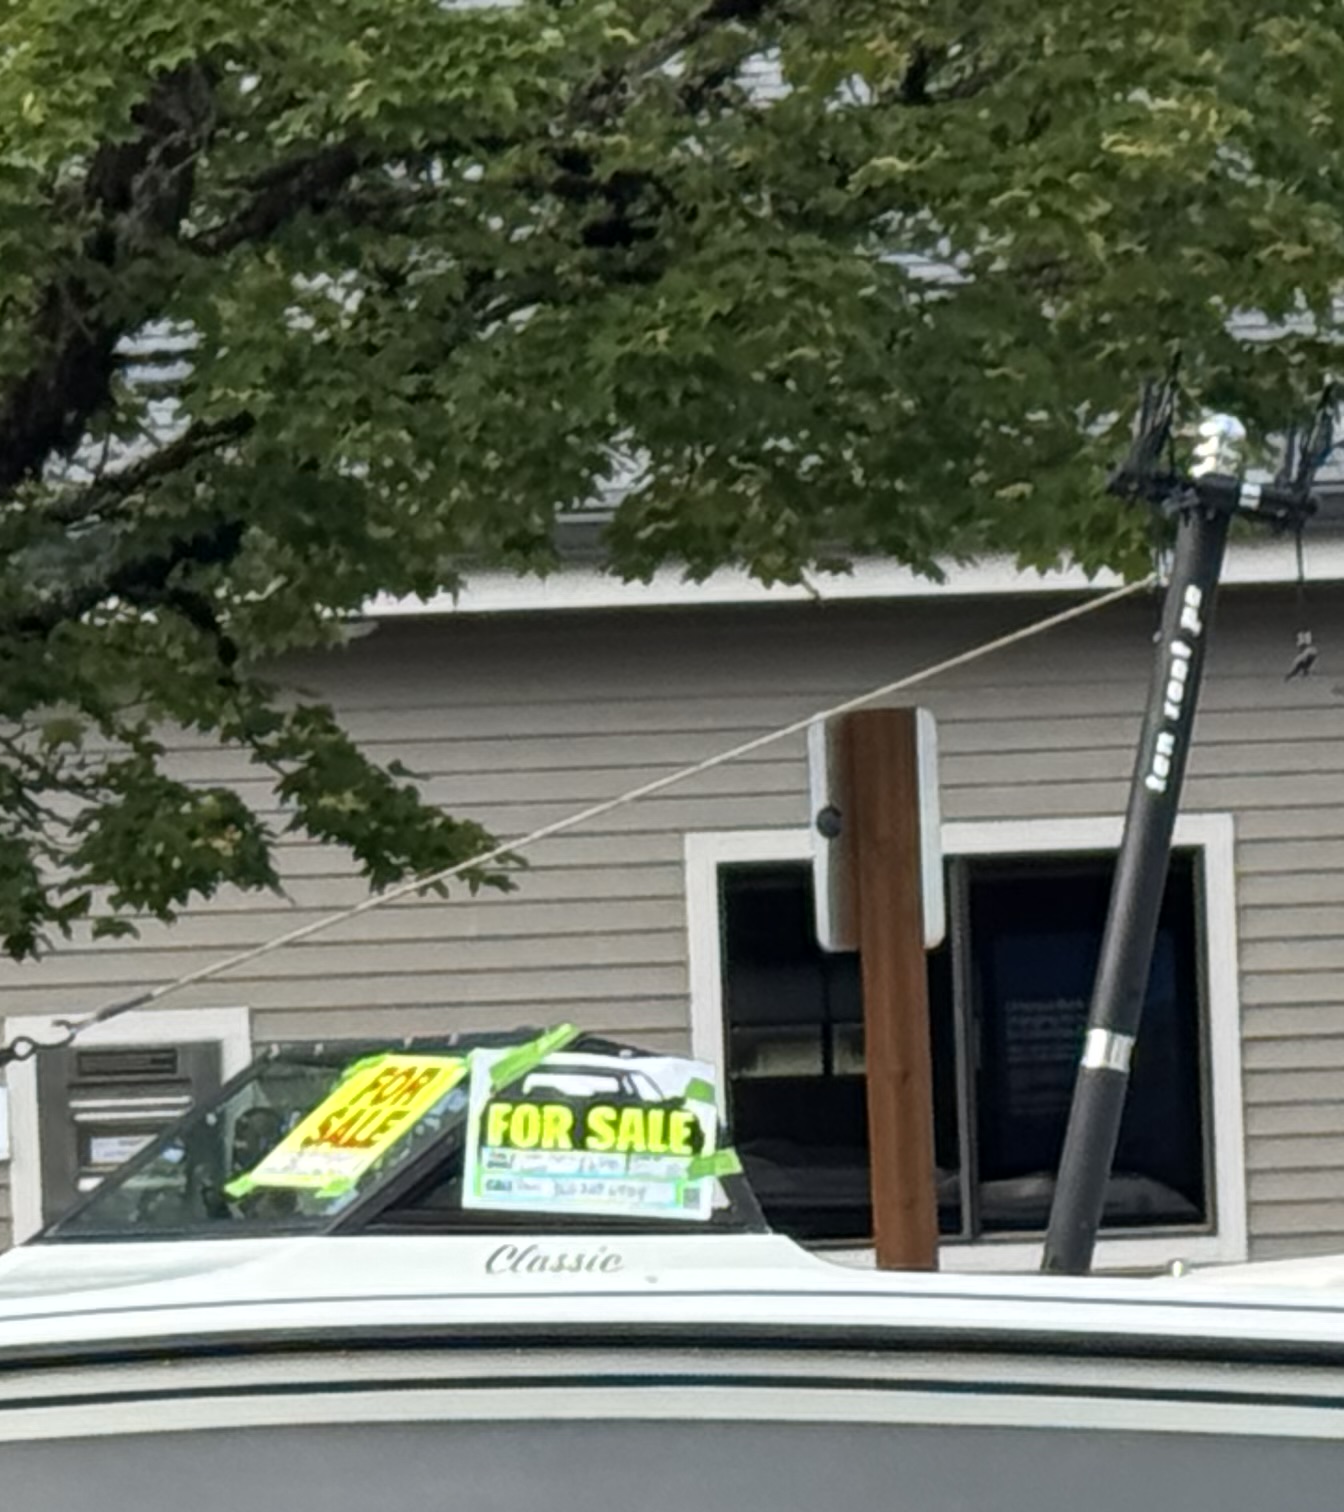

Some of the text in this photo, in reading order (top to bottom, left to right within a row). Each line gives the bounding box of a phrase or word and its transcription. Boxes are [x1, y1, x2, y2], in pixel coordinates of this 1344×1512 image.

[350, 1066, 441, 1106] FOR
[301, 1107, 412, 1149] SALE
[487, 1103, 692, 1153] FOR SALE
[484, 1243, 625, 1275] Classic
